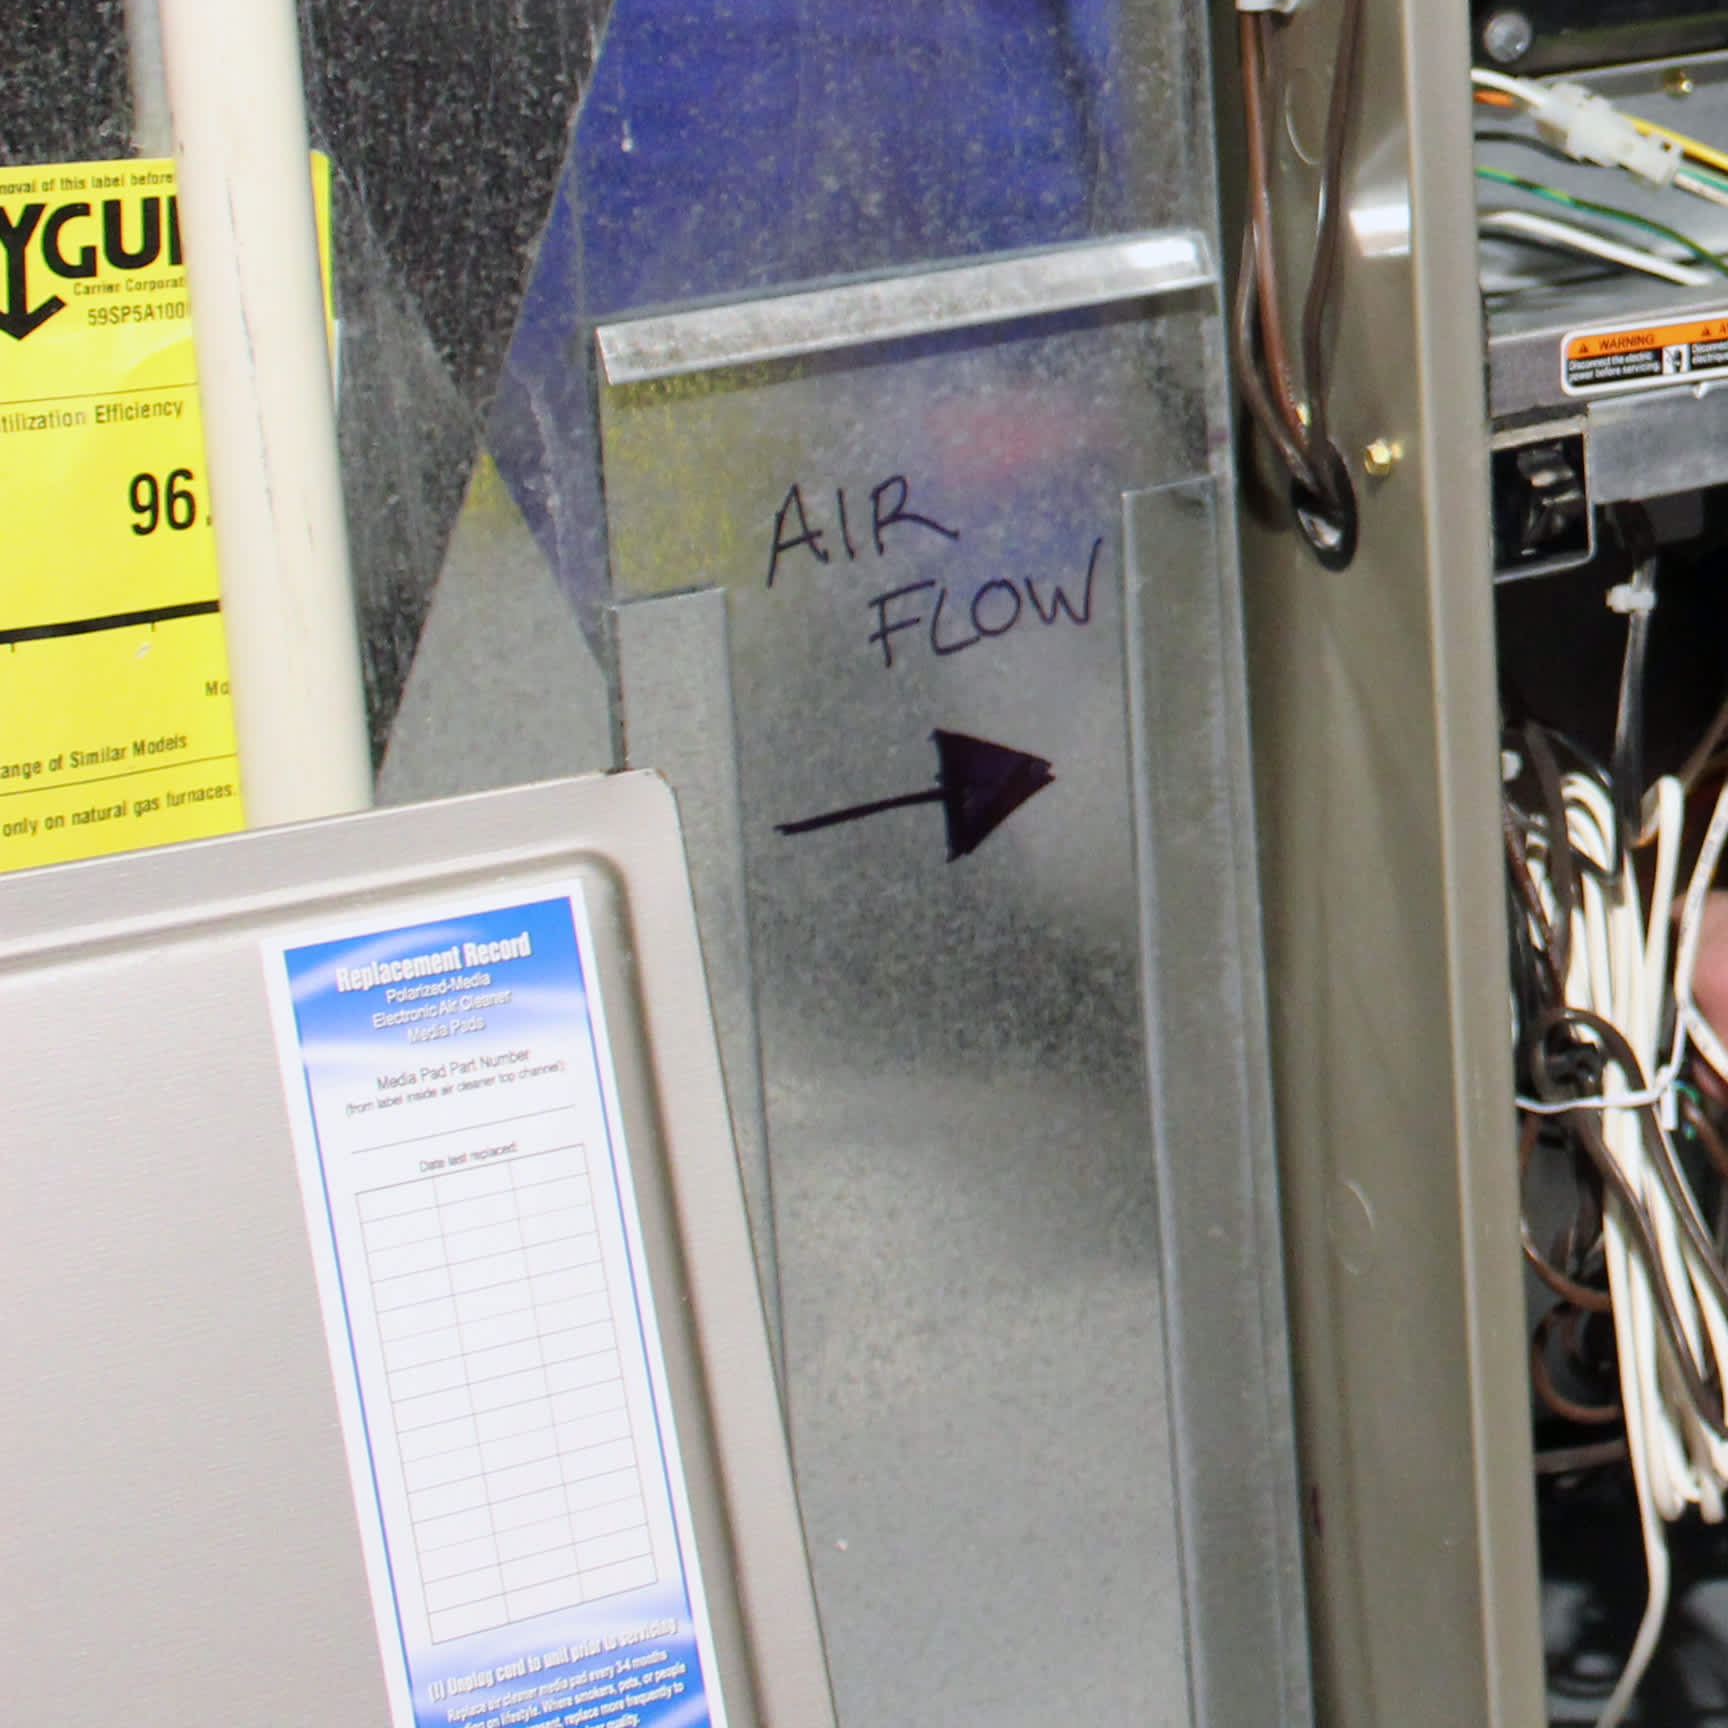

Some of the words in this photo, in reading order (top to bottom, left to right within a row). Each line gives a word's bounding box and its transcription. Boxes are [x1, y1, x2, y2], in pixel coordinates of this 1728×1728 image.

[42, 178, 55, 192] of
[60, 177, 86, 190] this
[91, 172, 125, 189] label
[130, 171, 173, 187] before
[73, 281, 121, 296] Carrier
[87, 302, 188, 326] 59SP5A100
[1600, 334, 1655, 350] WARNING
[95, 400, 184, 425] Efficiency
[767, 474, 960, 589] AIR
[868, 536, 1102, 669] FLOW
[0, 760, 42, 780] ange
[48, 753, 64, 772] of
[70, 745, 127, 769] Similar
[132, 733, 188, 757] Models
[3, 817, 39, 839] only
[44, 815, 65, 831] on
[71, 799, 127, 826] natural
[133, 796, 160, 818] gas
[336, 946, 462, 993] Replacement
[463, 931, 532, 967] Record
[386, 971, 492, 1004] Polarized-Media
[372, 1004, 438, 1029] Electronic
[439, 998, 458, 1016] Air
[460, 989, 512, 1011] Cleaner
[408, 1023, 449, 1043] Media
[450, 1016, 486, 1035] Pads
[377, 1071, 417, 1091] Media
[420, 1064, 448, 1081] Pad
[449, 1058, 477, 1076] Part
[479, 1049, 530, 1069] Number
[448, 1670, 495, 1696] Unplug
[496, 1658, 527, 1682] cord
[527, 1655, 543, 1672] to
[543, 1647, 570, 1669] unit
[570, 1639, 602, 1664] prior
[619, 1618, 678, 1648] servicing
